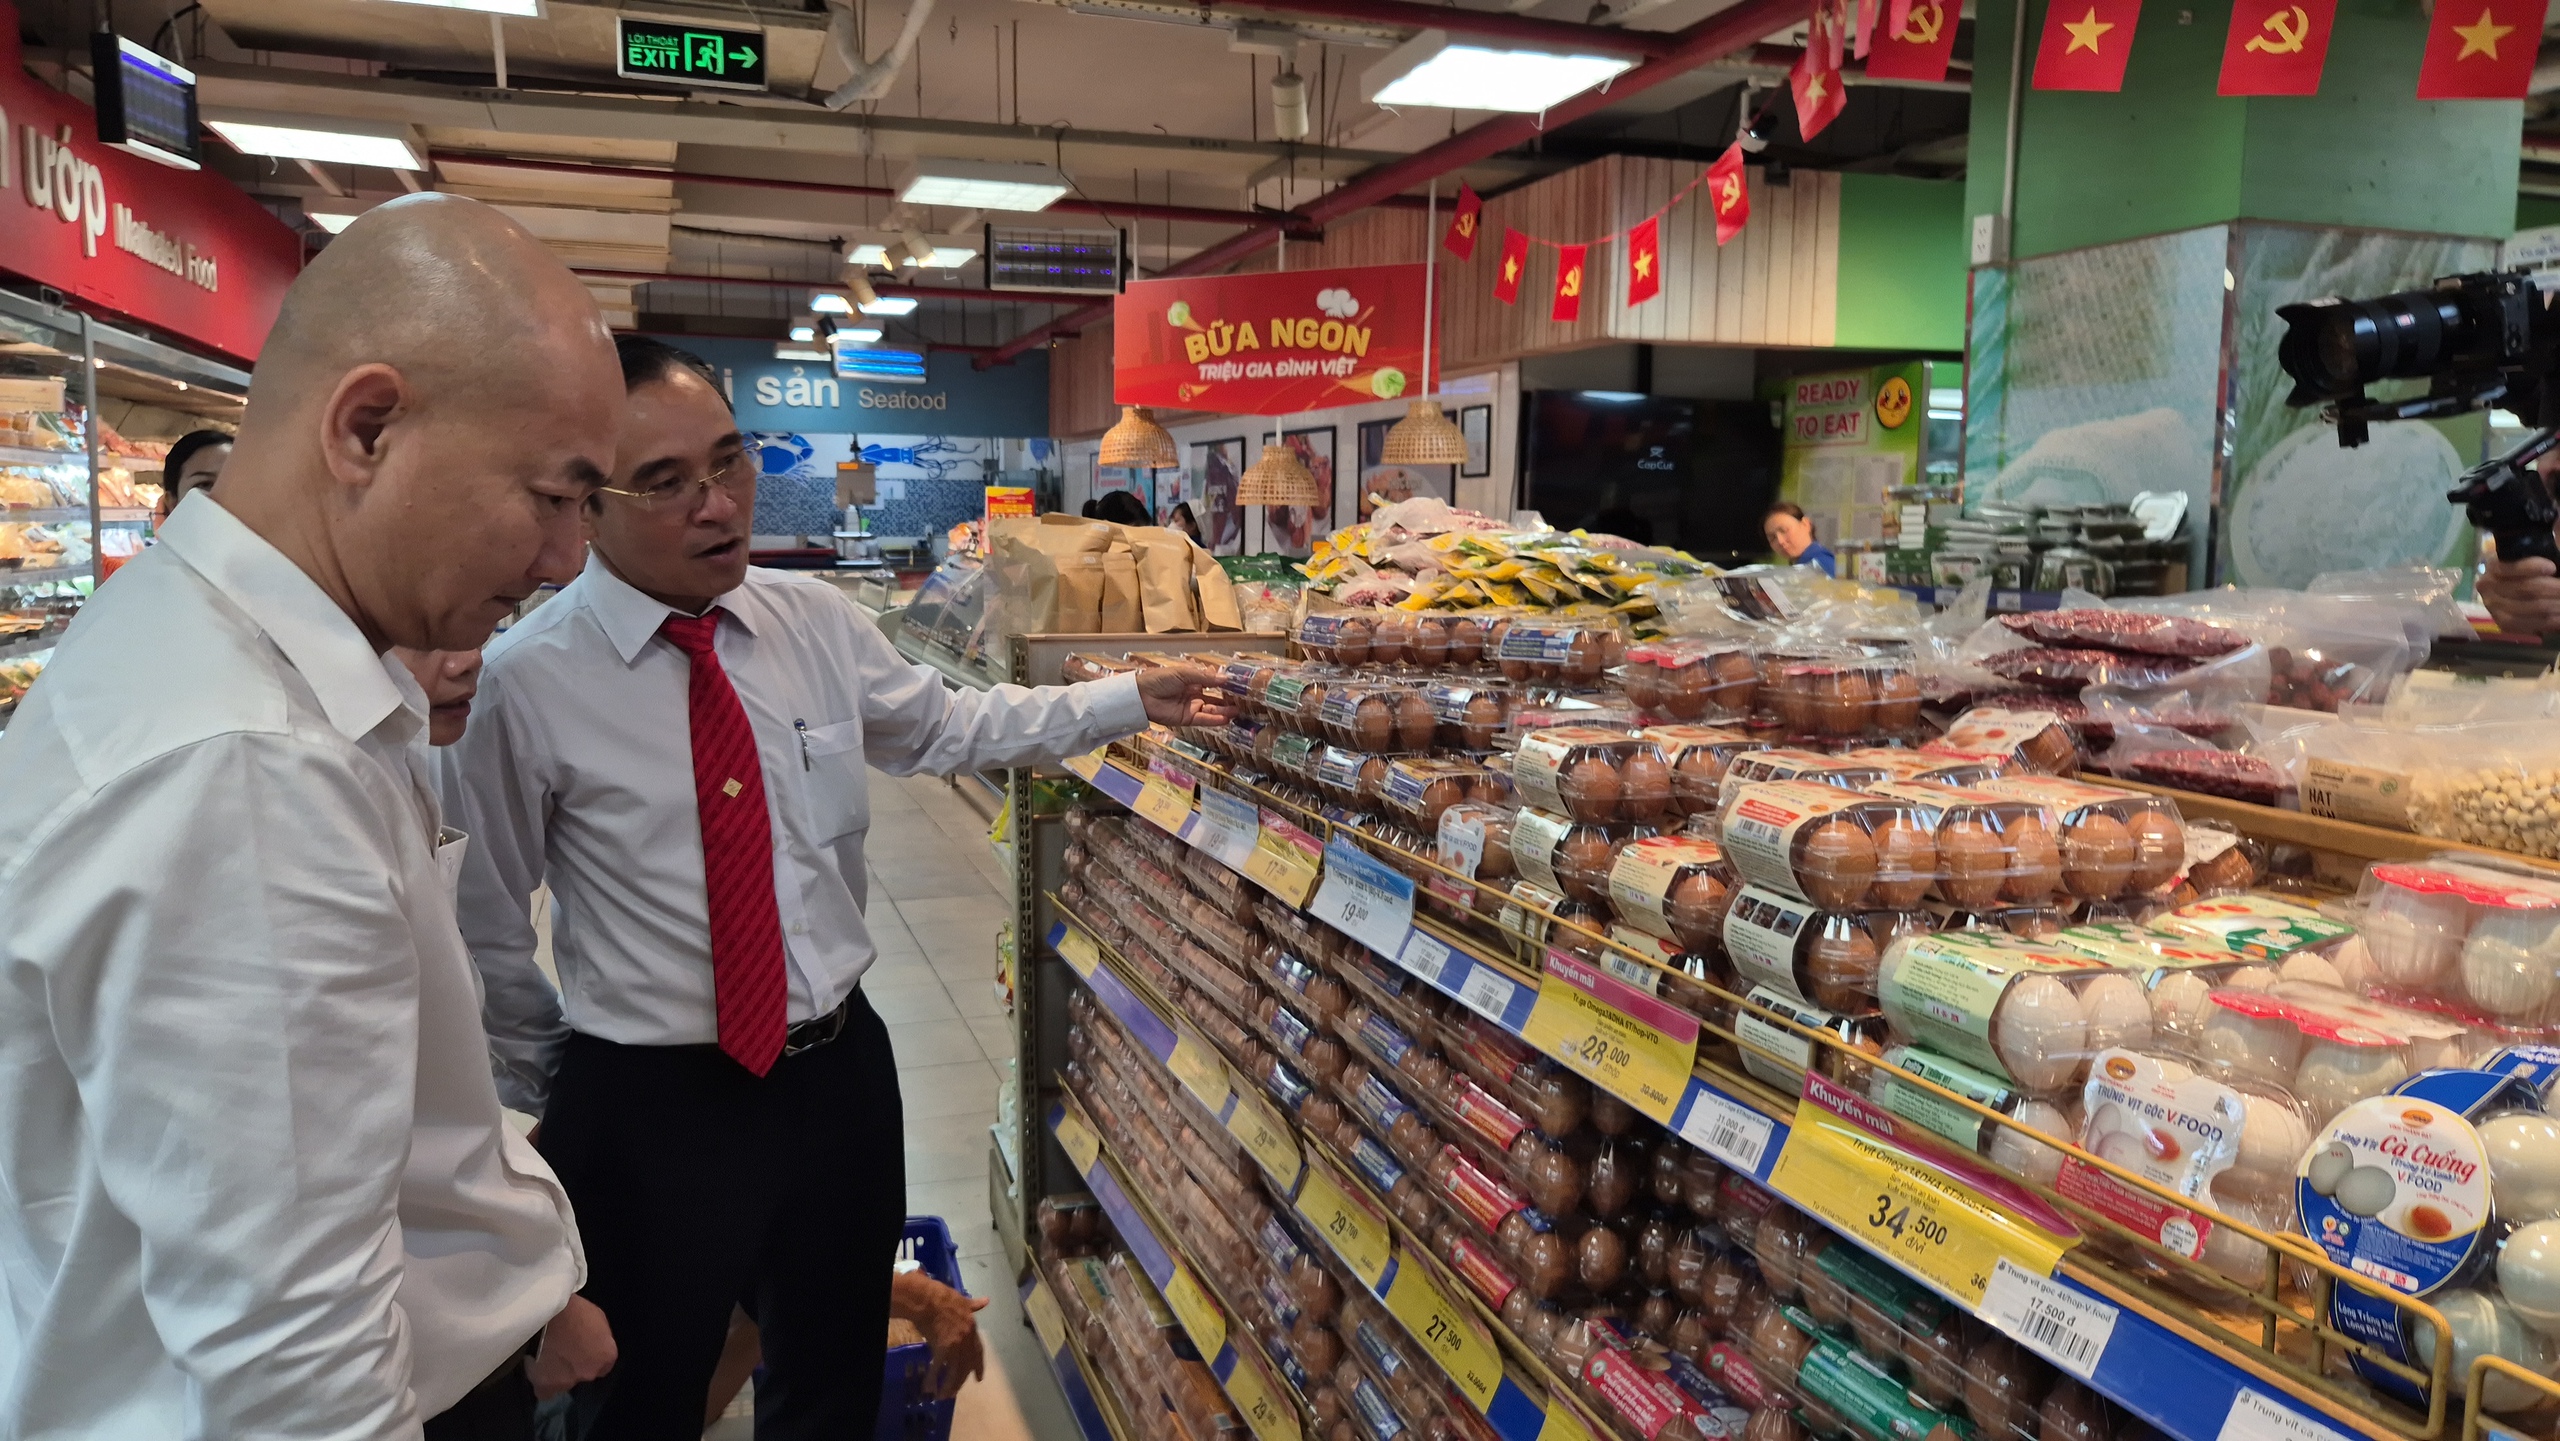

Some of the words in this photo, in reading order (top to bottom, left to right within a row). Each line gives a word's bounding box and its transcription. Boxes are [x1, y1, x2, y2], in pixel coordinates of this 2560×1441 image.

[628, 47, 680, 70] EXIT
[21, 124, 107, 258] ướp
[1185, 319, 1260, 364] BỮA
[1270, 317, 1372, 357] NGON
[1199, 360, 1244, 382] TRIỆU
[1245, 362, 1274, 378] GIA
[1275, 357, 1319, 377] ĐÌNH
[1322, 356, 1358, 377] VIỆT
[755, 366, 840, 408] sản
[858, 388, 947, 410] Seafood
[1798, 378, 1861, 405] READY
[1795, 414, 1820, 438] TO
[1823, 410, 1861, 436] EAT
[1637, 458, 1675, 472] CapCut
[1549, 955, 1580, 981] Khuyến
[1579, 974, 1595, 989] mãi
[1809, 1079, 1864, 1121] Khuyến
[1864, 1112, 1895, 1137] mãi
[2127, 1095, 2143, 1113] VỊT
[2166, 1107, 2223, 1142] V.FOOD
[2380, 1134, 2408, 1159] Cà
[2411, 1148, 2477, 1186] Cuống
[2397, 1170, 2442, 1194] V.FOOD
[1868, 1194, 1948, 1246] 34.500
[2006, 1265, 2029, 1285] Trung
[2040, 1283, 2056, 1298] goc
[2029, 1296, 2066, 1323] 17.500
[2066, 1315, 2077, 1328] đ
[1425, 1313, 1462, 1352] 27.500
[2251, 1399, 2283, 1425] Trung
[2284, 1417, 2299, 1433] vit
